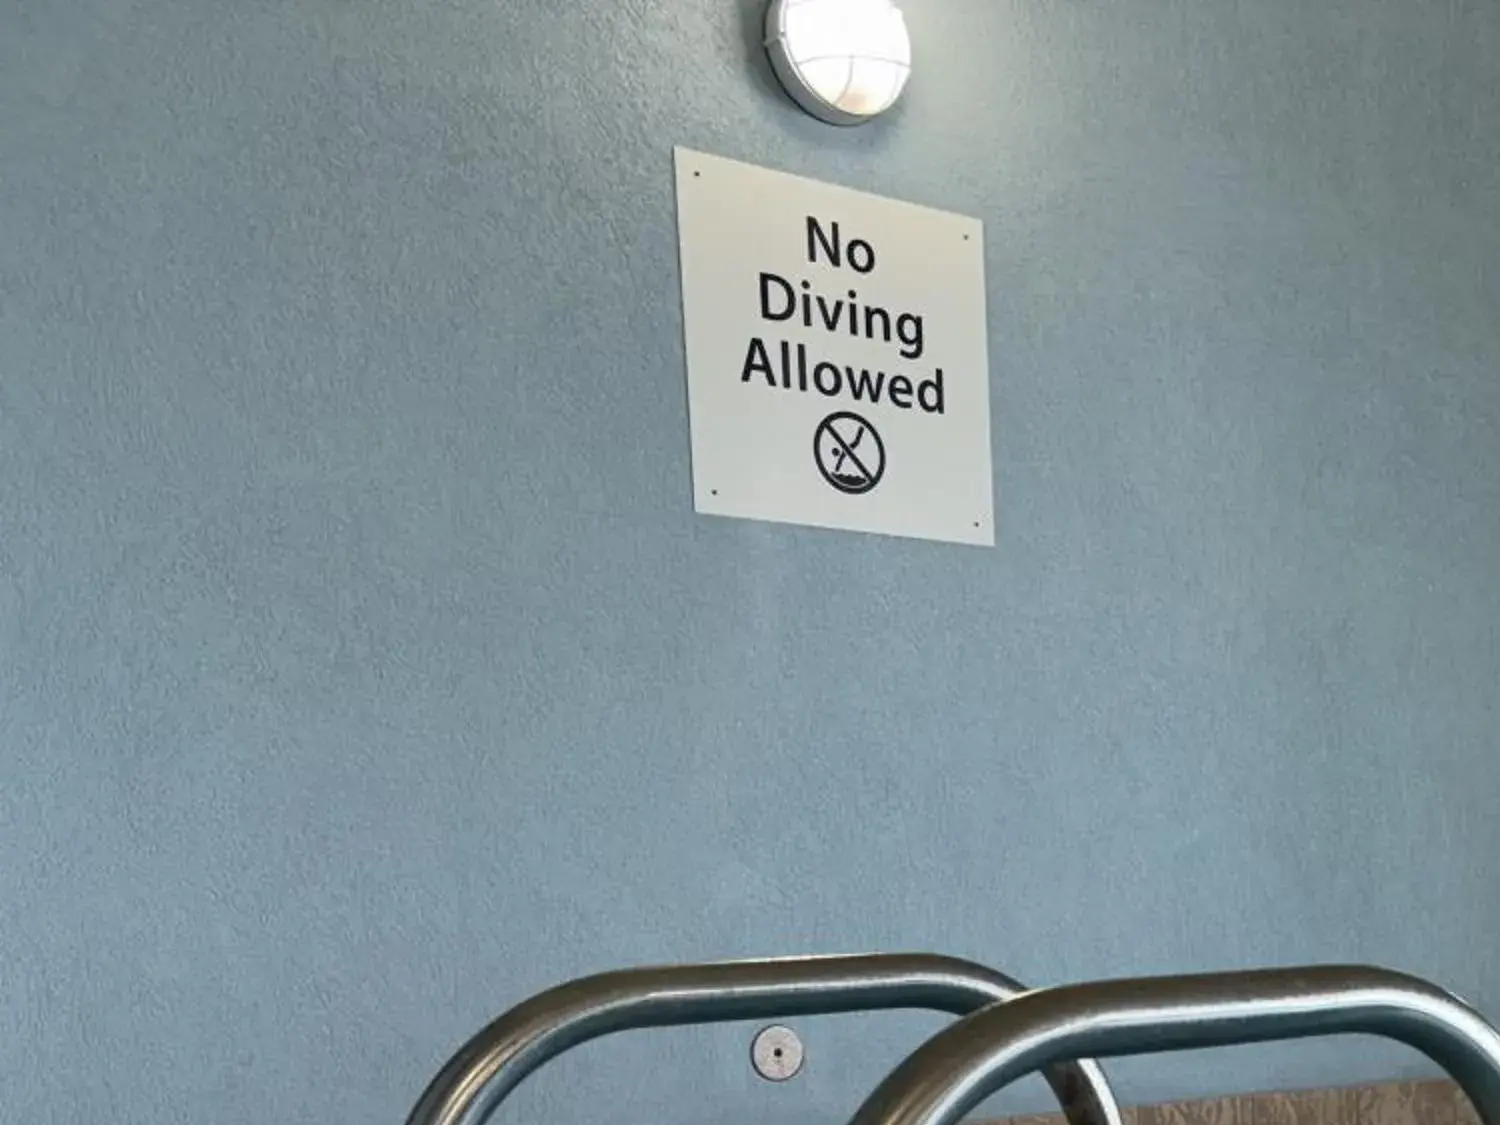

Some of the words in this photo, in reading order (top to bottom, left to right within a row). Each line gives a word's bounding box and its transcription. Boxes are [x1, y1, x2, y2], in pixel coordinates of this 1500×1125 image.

[805, 215, 876, 273] No
[758, 272, 924, 359] Diving
[740, 336, 945, 415] Allowed
